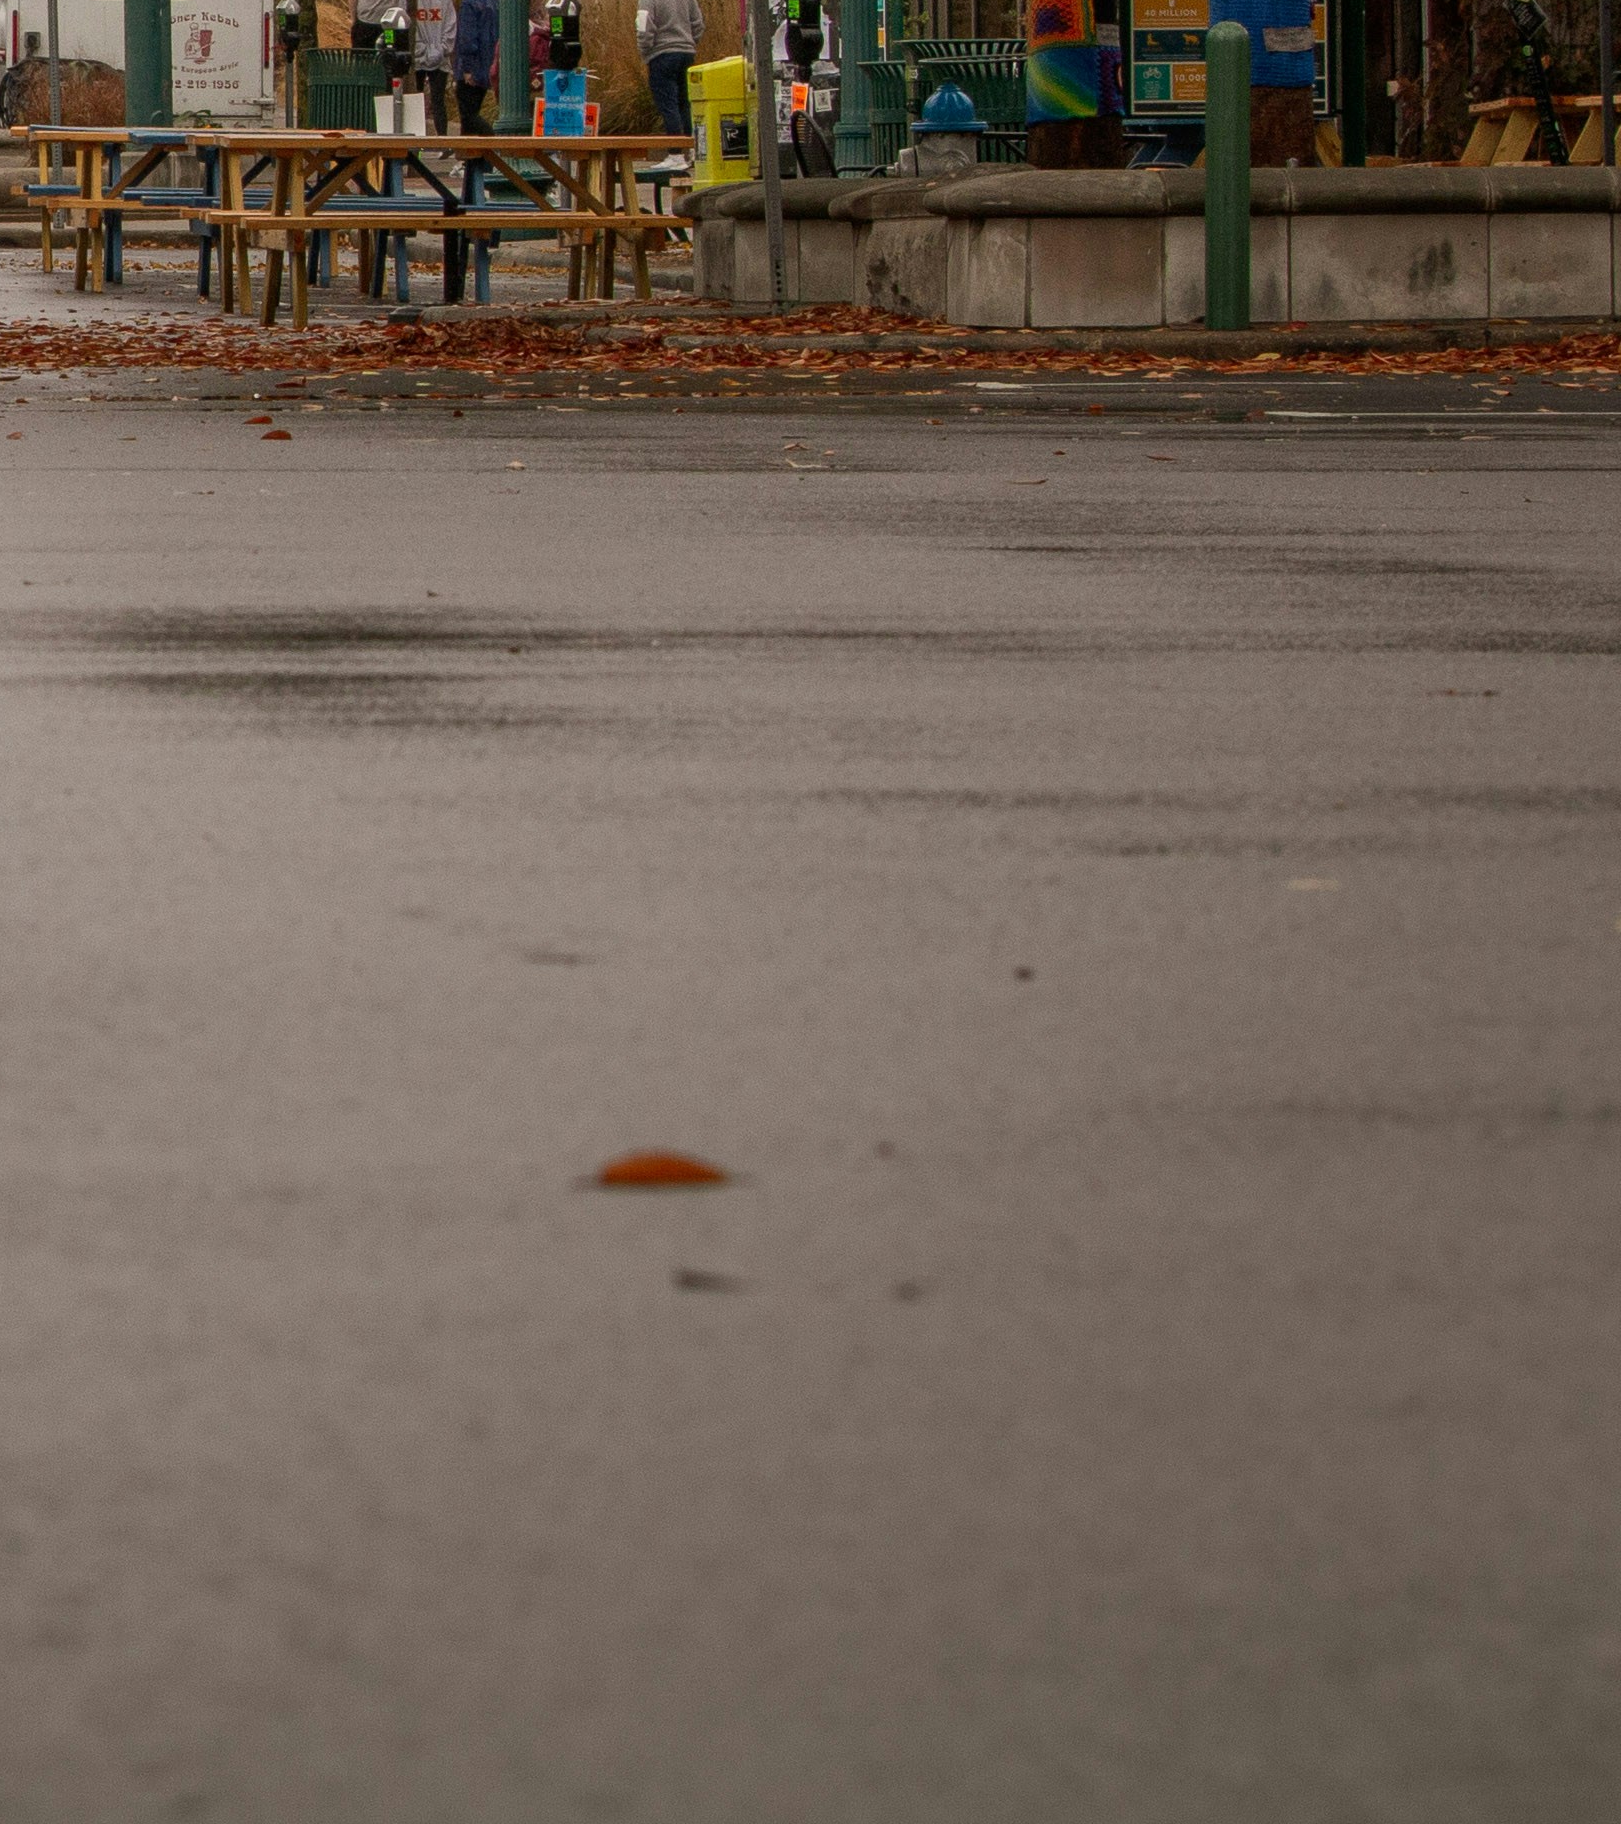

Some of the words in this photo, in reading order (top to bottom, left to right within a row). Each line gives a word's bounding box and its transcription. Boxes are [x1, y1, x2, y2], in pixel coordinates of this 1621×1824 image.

[1144, 9, 1156, 17] 40
[1159, 8, 1198, 17] MILLION
[201, 11, 240, 29] Kebab
